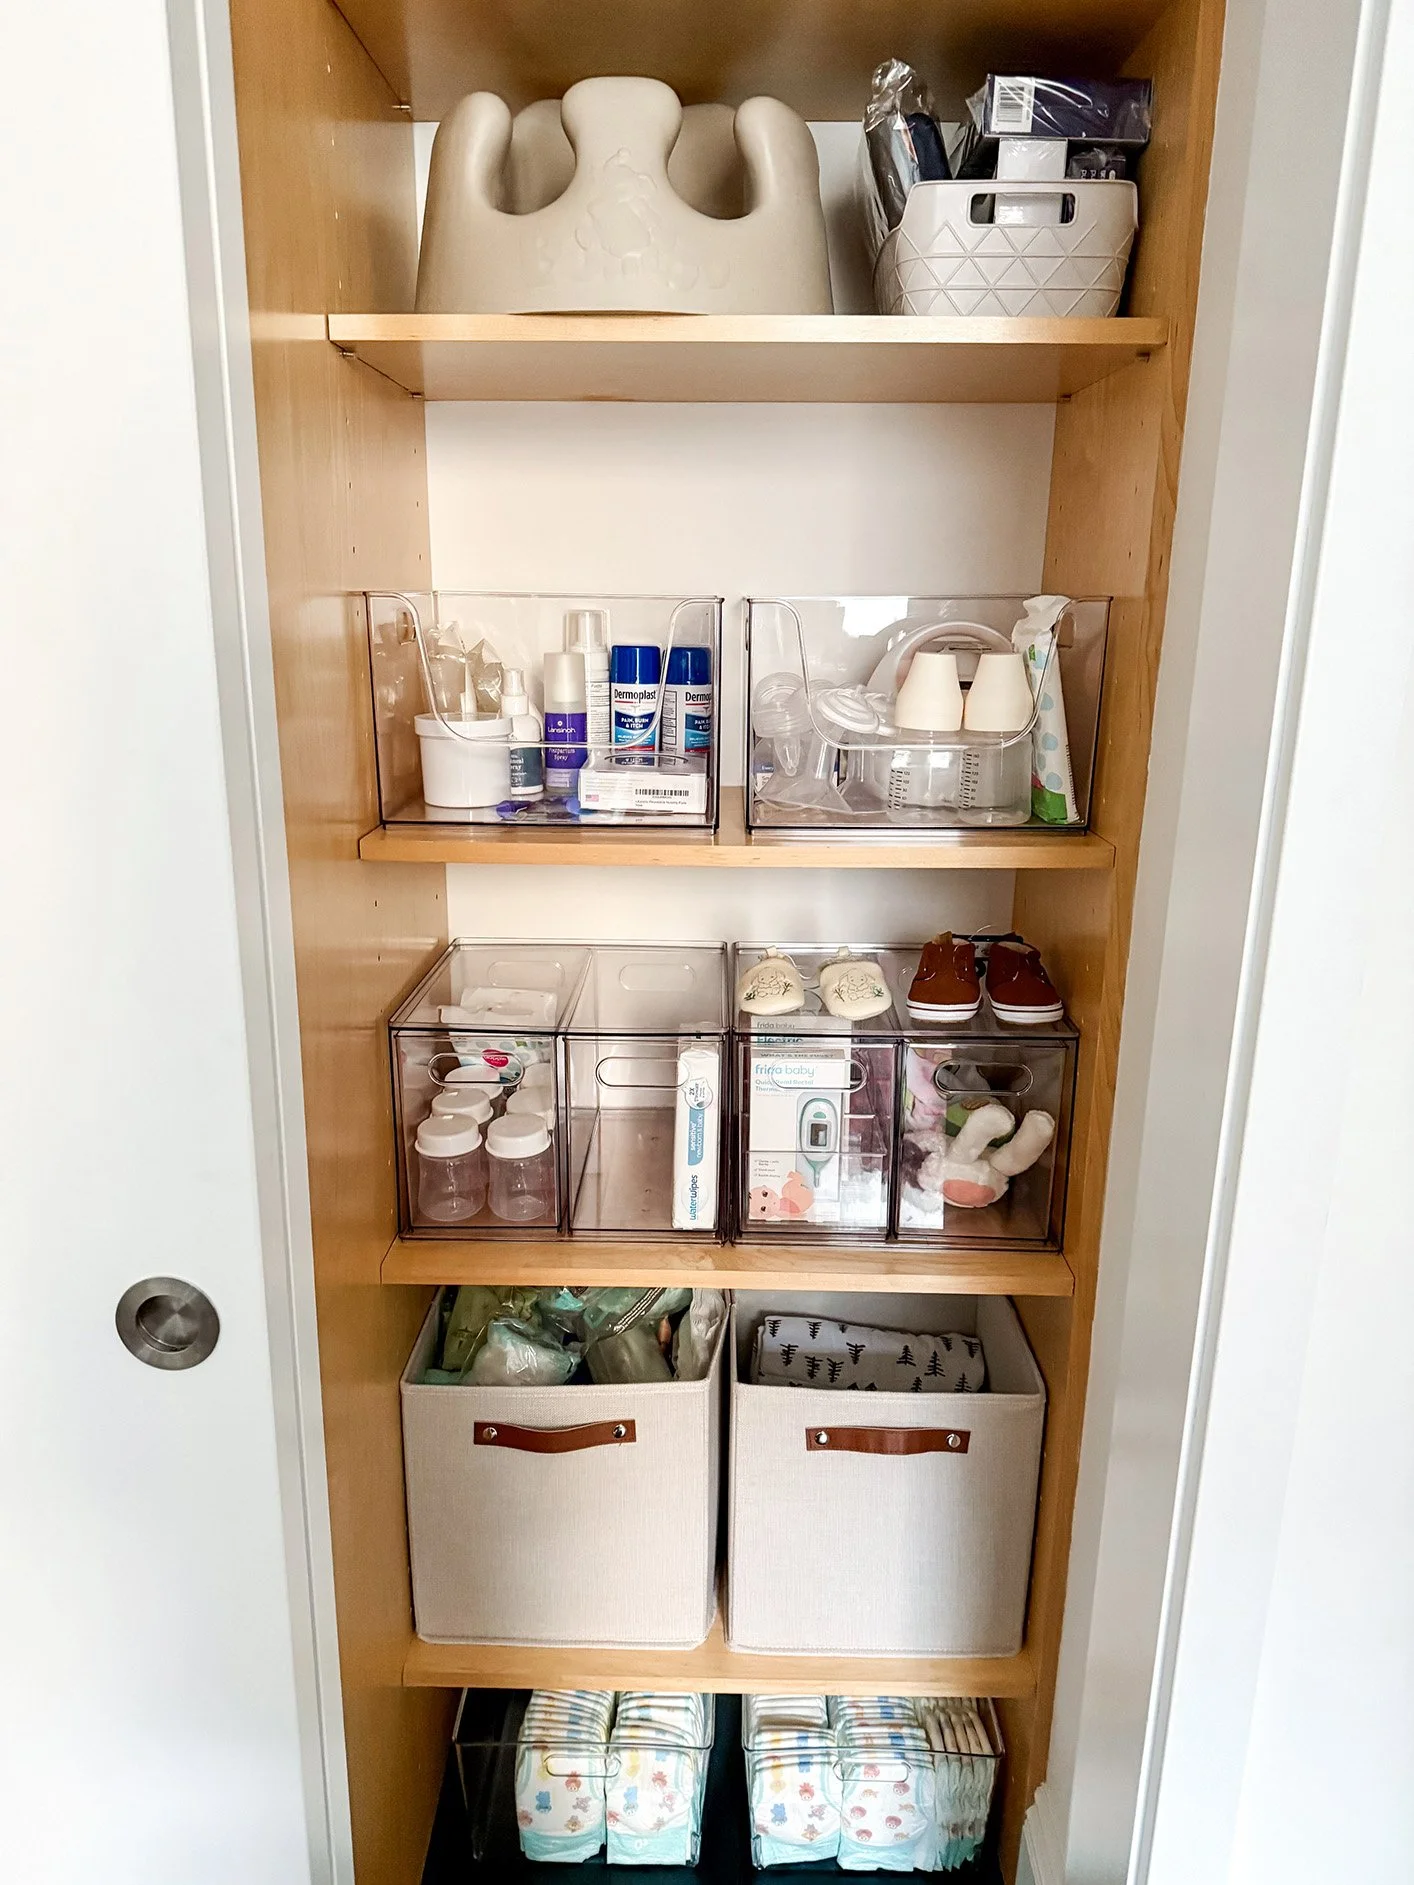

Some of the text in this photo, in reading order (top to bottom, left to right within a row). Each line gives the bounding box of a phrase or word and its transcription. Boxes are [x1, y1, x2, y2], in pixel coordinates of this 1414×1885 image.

[614, 689, 656, 703] Dermoplast
[757, 1021, 774, 1029] frida
[785, 1064, 815, 1077] baby
[689, 1174, 699, 1220] waterwipes
